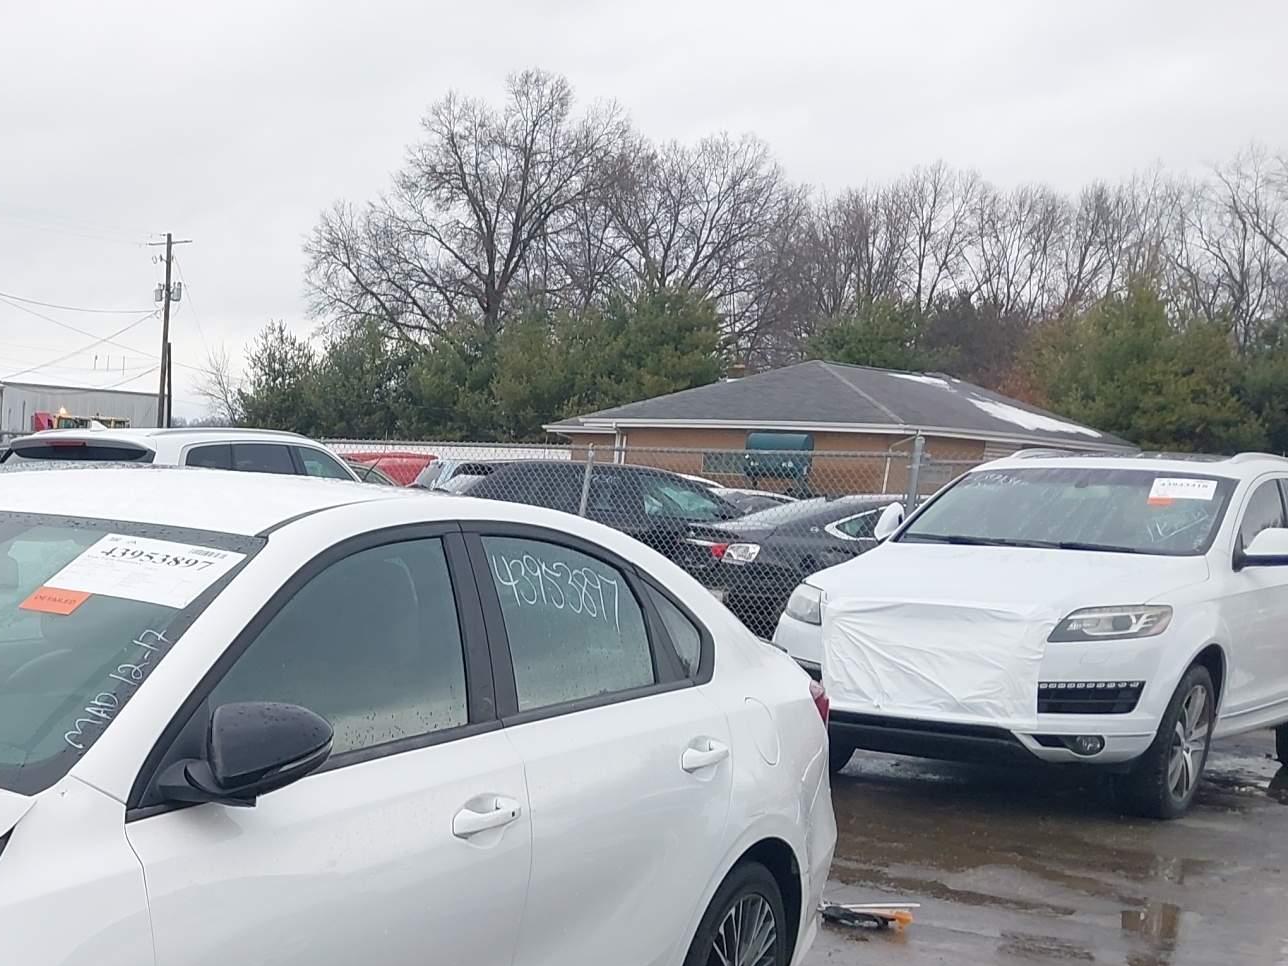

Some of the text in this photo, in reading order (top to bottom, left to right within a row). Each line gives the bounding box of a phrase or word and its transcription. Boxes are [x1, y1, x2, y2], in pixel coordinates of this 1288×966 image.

[101, 546, 213, 571] 43953897
[492, 554, 620, 632] 43953897
[64, 692, 119, 748] MAD
